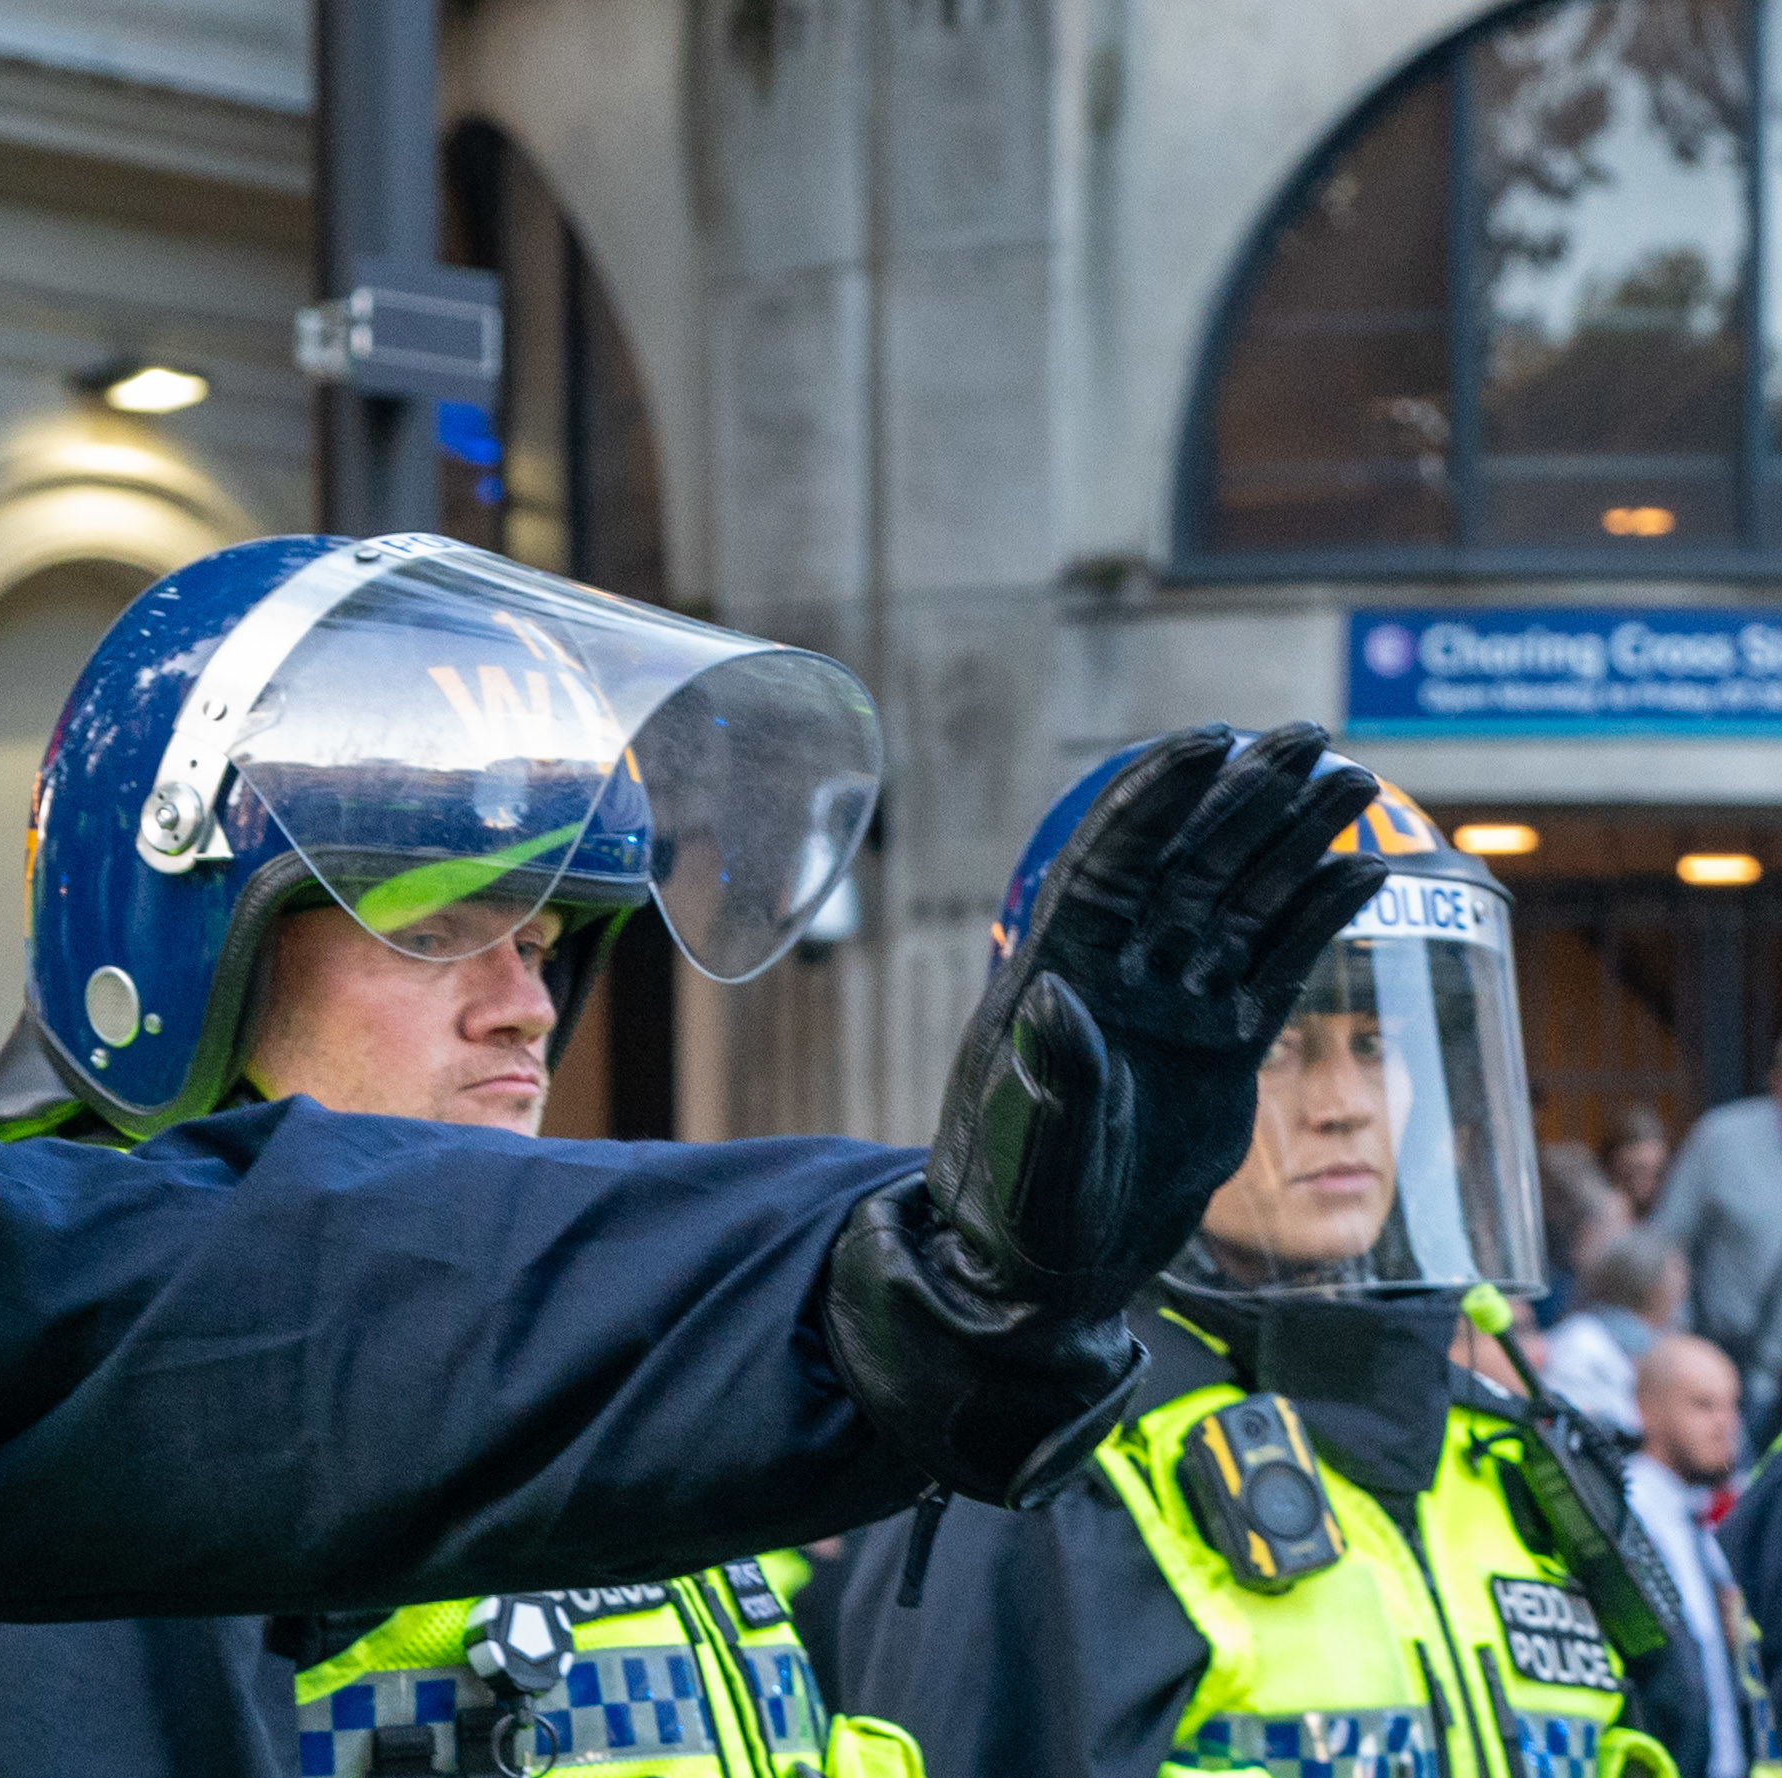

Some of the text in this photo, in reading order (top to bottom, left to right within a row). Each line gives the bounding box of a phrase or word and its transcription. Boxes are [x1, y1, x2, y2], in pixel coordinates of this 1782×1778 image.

[1421, 623, 1606, 680] Charing
[1612, 623, 1734, 676] Cross
[1508, 1629, 1618, 1691] POLICE
